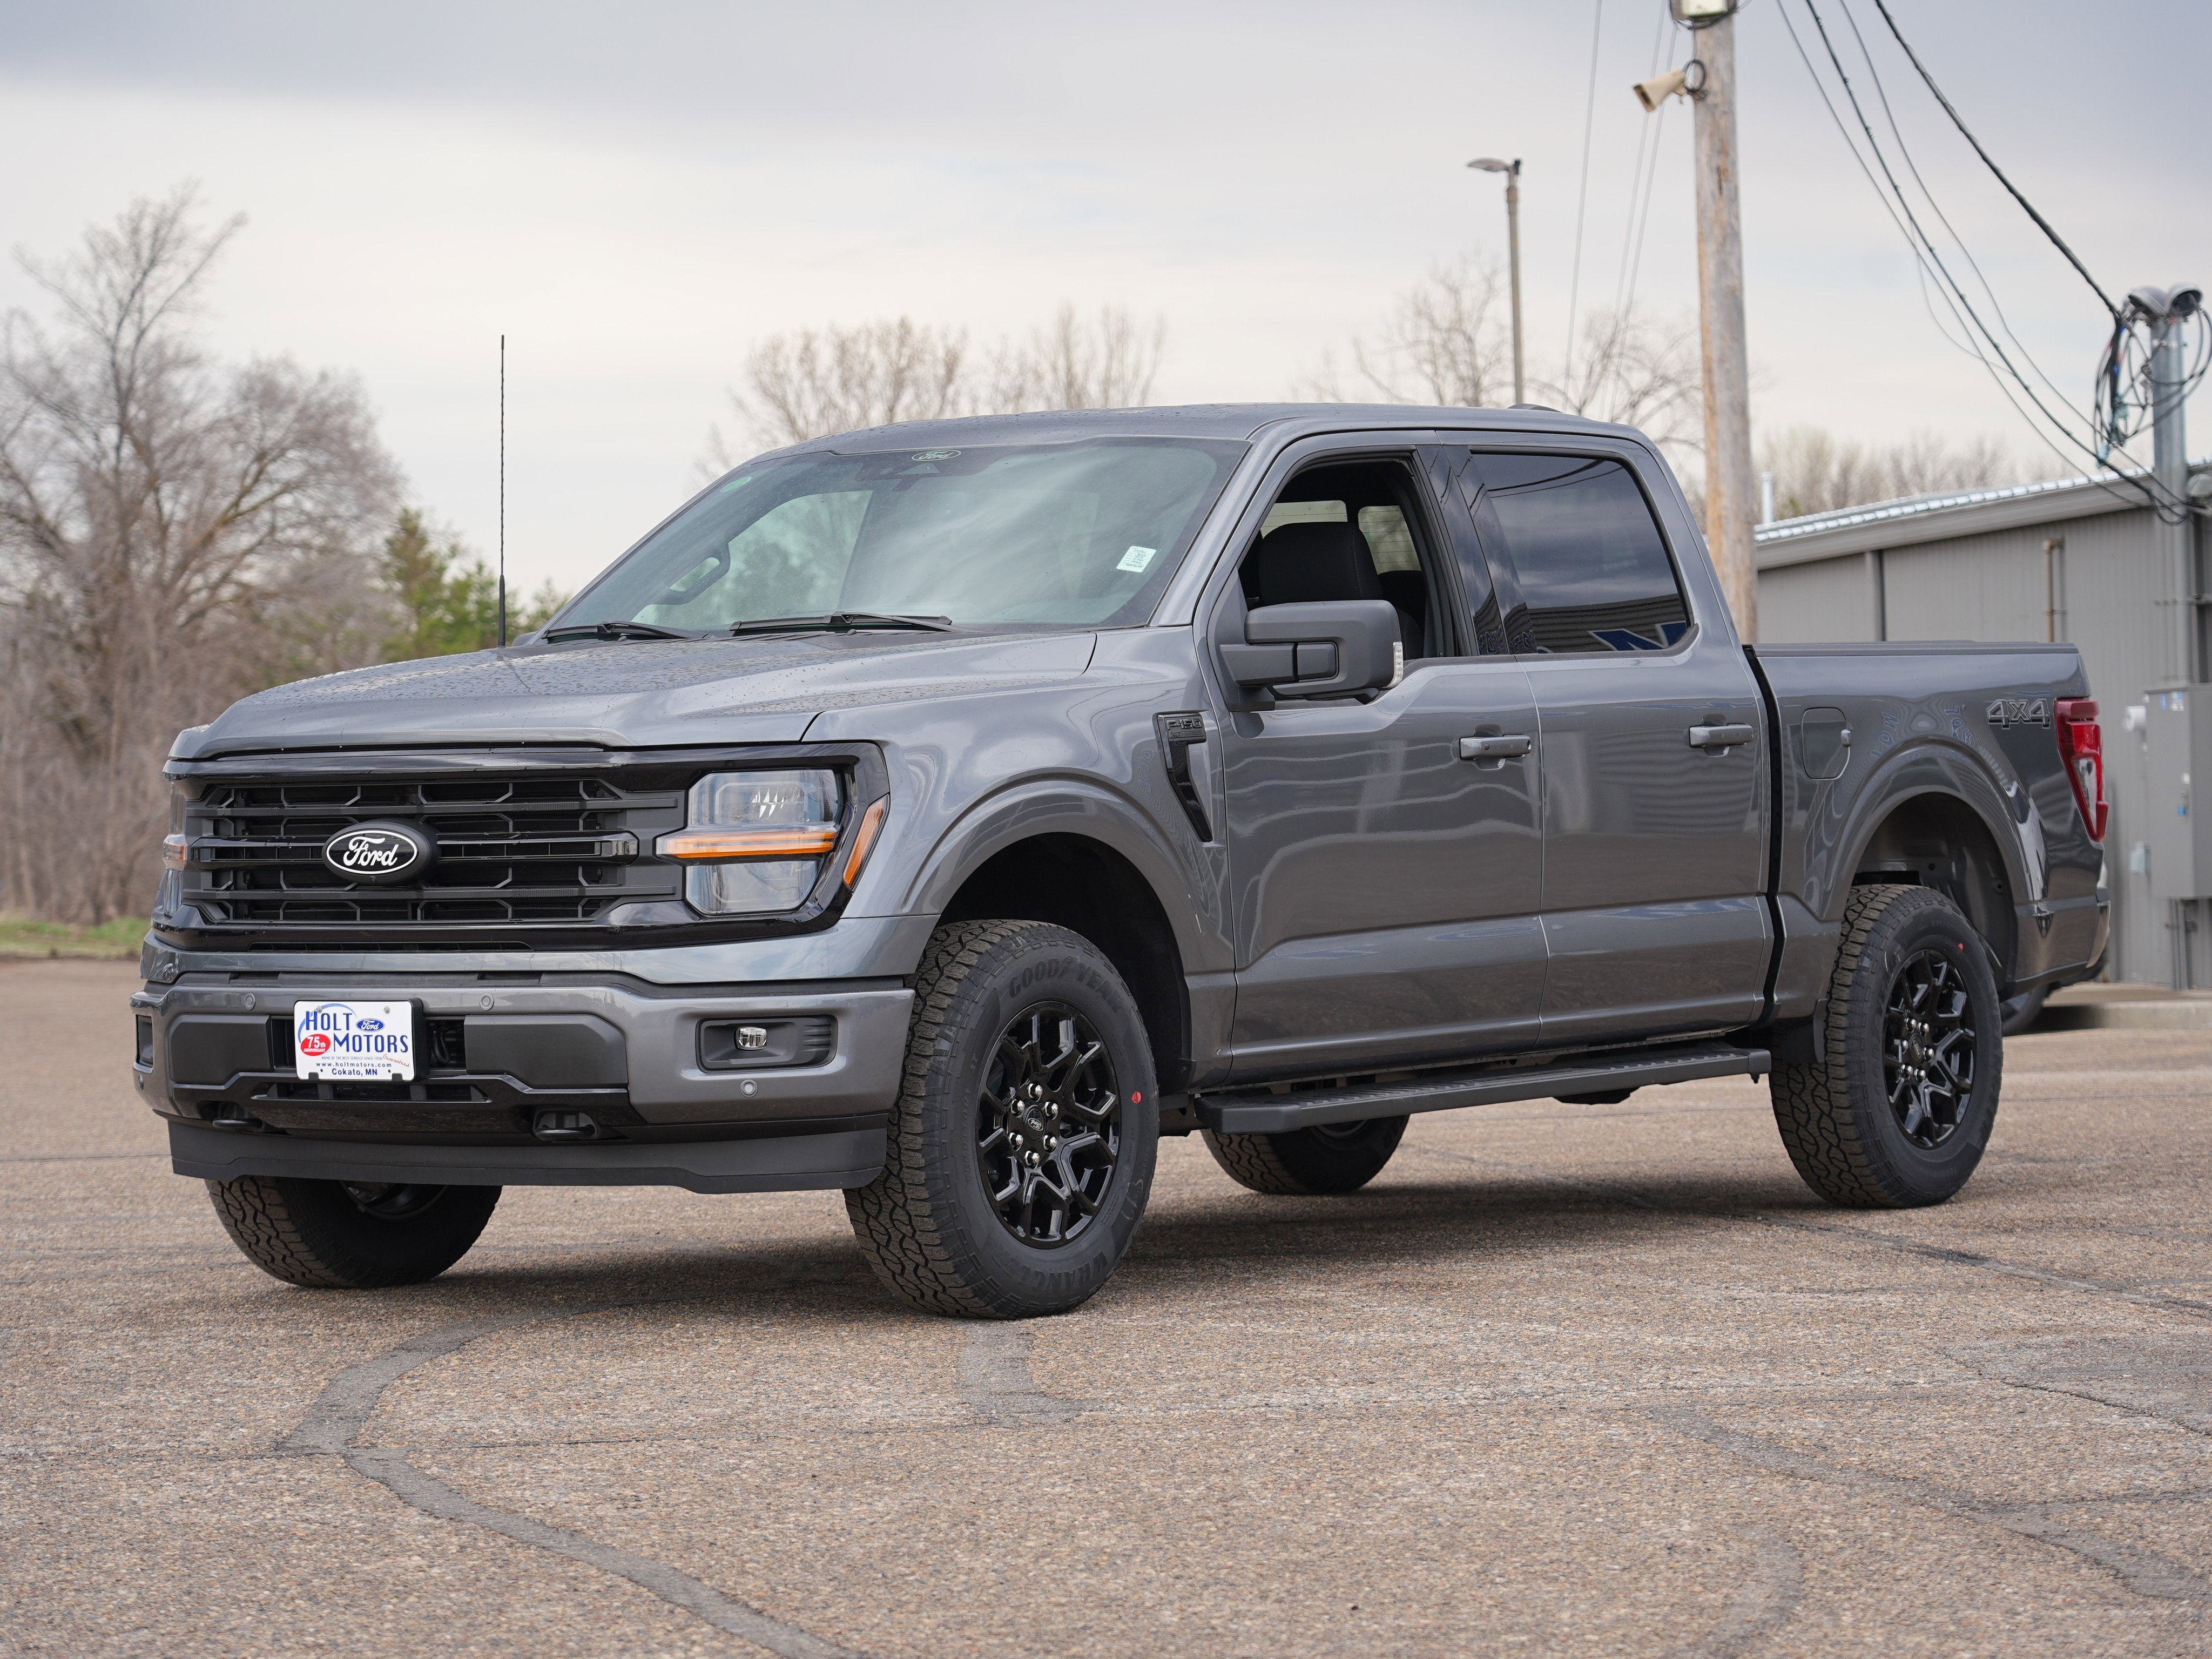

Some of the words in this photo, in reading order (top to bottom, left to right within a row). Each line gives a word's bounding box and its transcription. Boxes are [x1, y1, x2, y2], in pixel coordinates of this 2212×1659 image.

[918, 451, 954, 459] Ford
[1166, 718, 1203, 730] F-150
[343, 836, 399, 866] Ford
[305, 1011, 352, 1031] HOLT
[361, 1020, 380, 1030] Ford
[307, 1036, 326, 1048] 75th
[333, 1033, 408, 1053] MOTORS
[383, 1054, 410, 1067] Guaranteed
[332, 1068, 363, 1076] Cokato,
